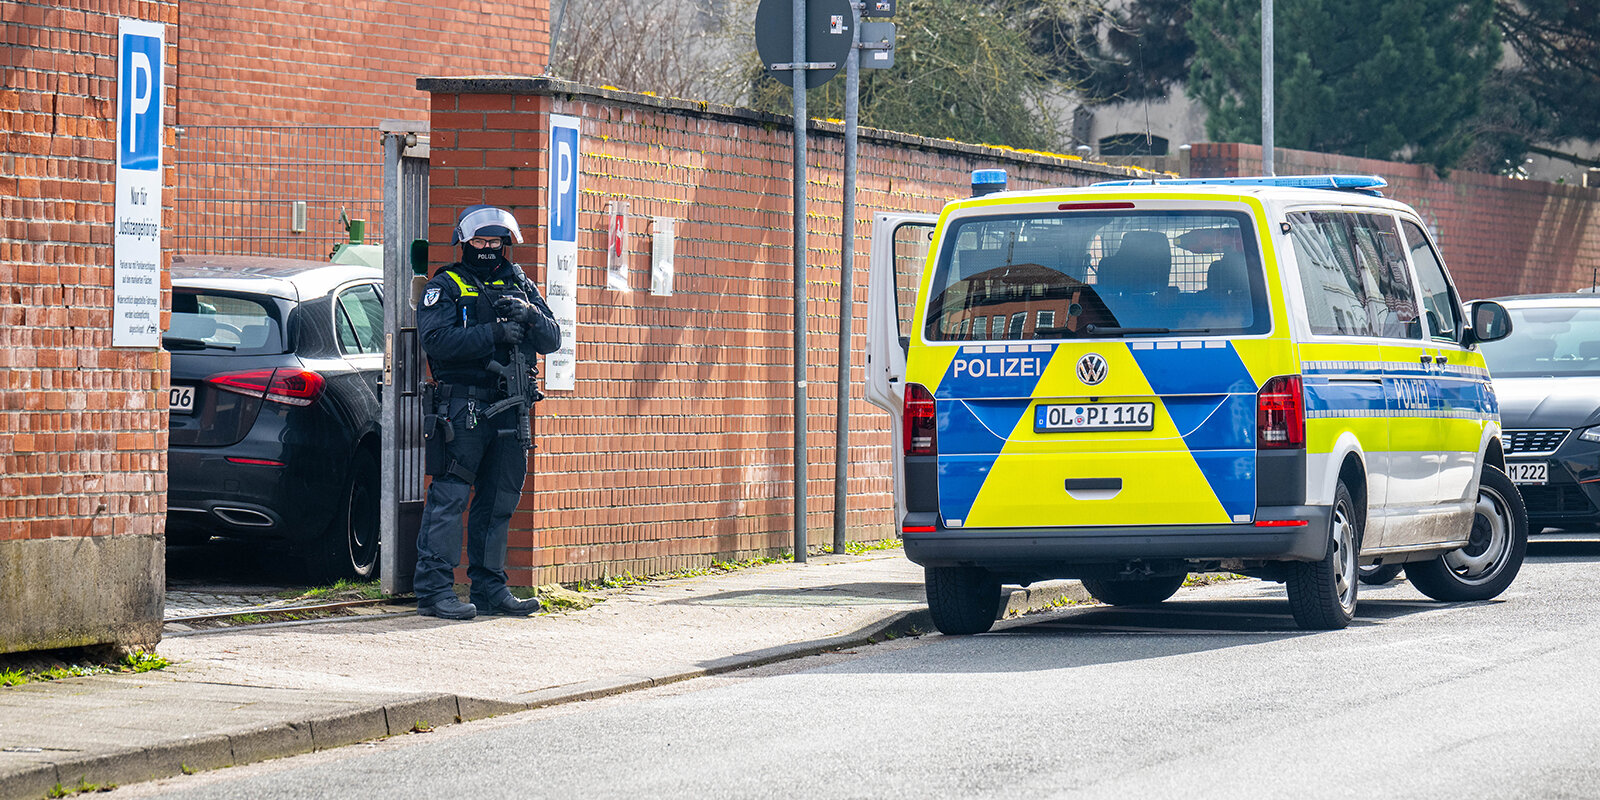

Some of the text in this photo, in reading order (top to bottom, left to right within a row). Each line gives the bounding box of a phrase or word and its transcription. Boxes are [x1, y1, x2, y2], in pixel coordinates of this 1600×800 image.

[130, 52, 152, 152] P
[557, 141, 571, 227] P
[131, 186, 139, 205] Nur
[119, 216, 157, 241] Justizangehörige
[954, 358, 1041, 378] POLIZEI
[1393, 378, 1430, 409] POLIZEI
[1049, 406, 1149, 425] OL PI 116
[1521, 465, 1546, 480] 222
